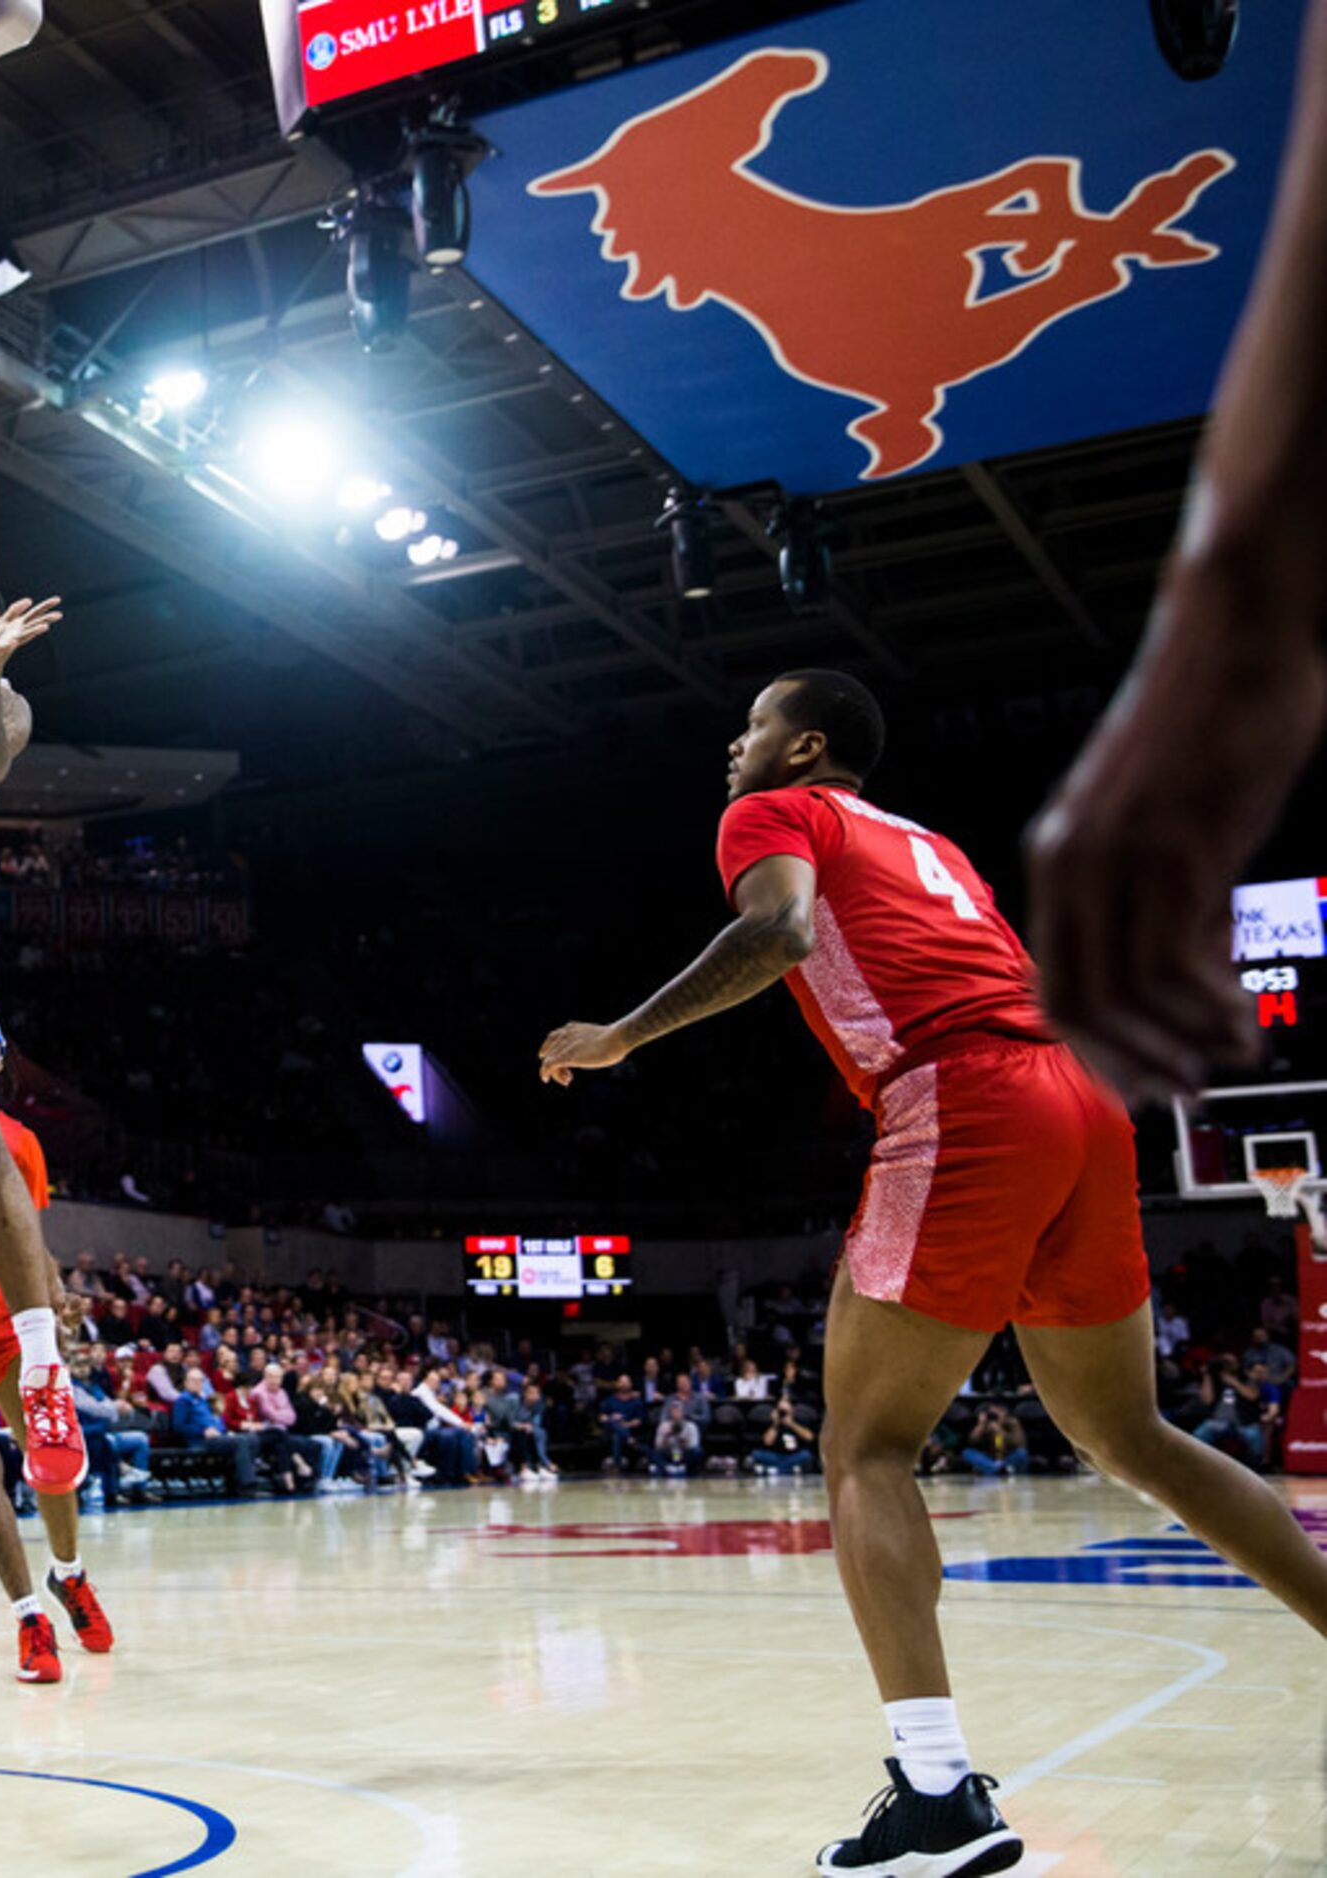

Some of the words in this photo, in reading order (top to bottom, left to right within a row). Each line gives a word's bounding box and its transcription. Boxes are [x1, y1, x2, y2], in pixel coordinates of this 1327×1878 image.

[339, 16, 398, 56] SMU
[405, 0, 475, 35] LYLE
[489, 9, 524, 40] FLS
[537, 0, 559, 25] 3
[907, 834, 982, 921] 4
[1242, 921, 1316, 944] TEXAS
[594, 1254, 615, 1279] 6
